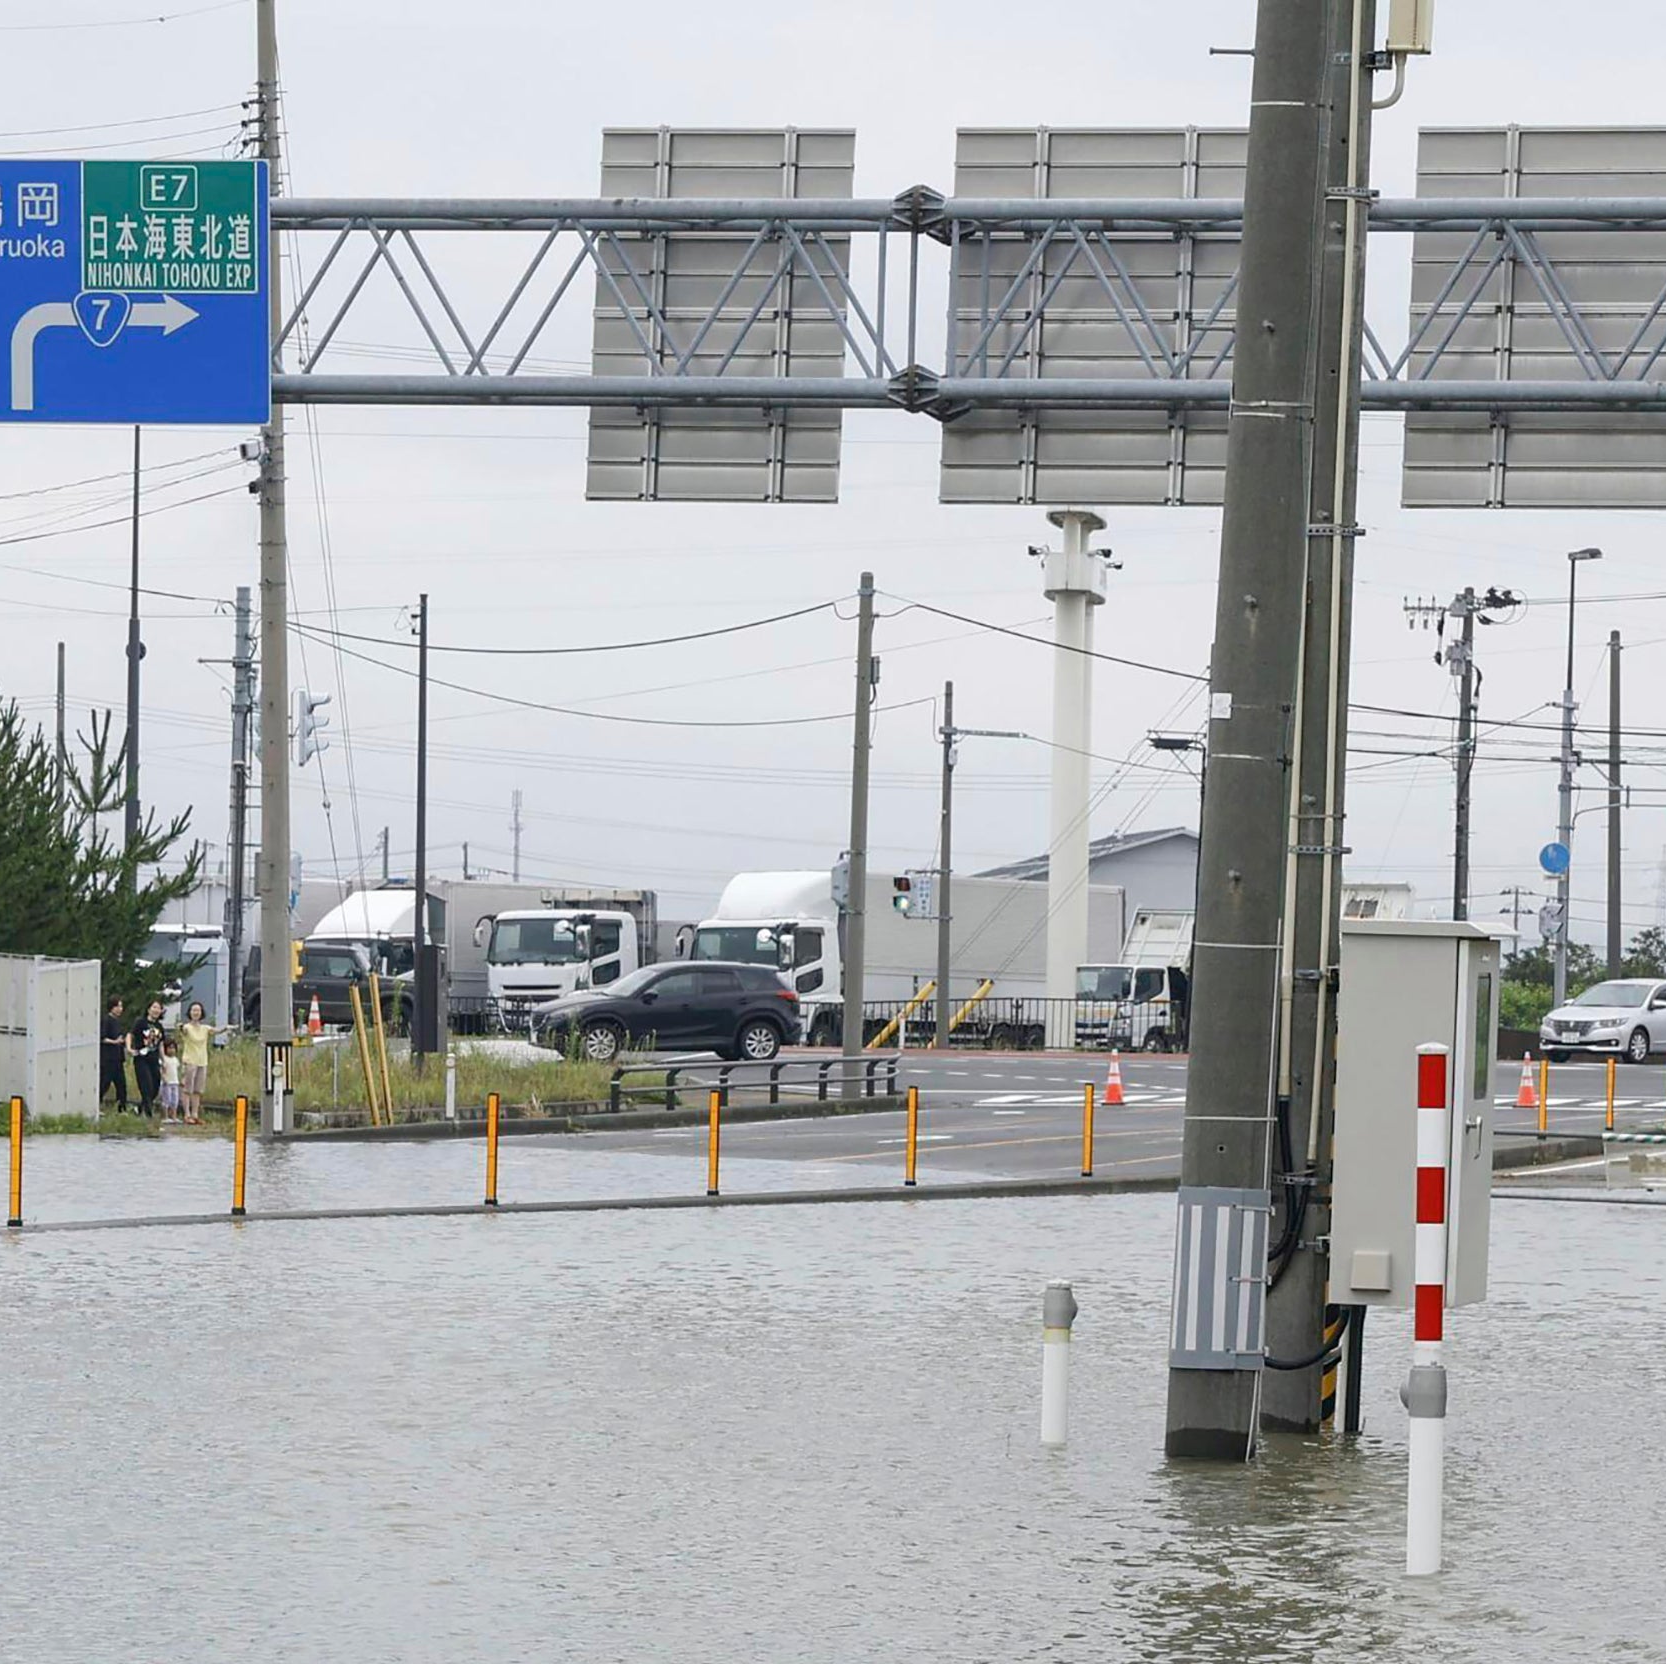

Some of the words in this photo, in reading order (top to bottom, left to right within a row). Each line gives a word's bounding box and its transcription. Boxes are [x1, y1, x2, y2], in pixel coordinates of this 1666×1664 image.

[150, 175, 188, 201] E7
[89, 213, 252, 260] 日本海東北道
[88, 263, 156, 287] NIHONKAI
[162, 264, 221, 288] TOHOKU
[226, 265, 251, 288] EXP
[91, 299, 111, 331] 7
